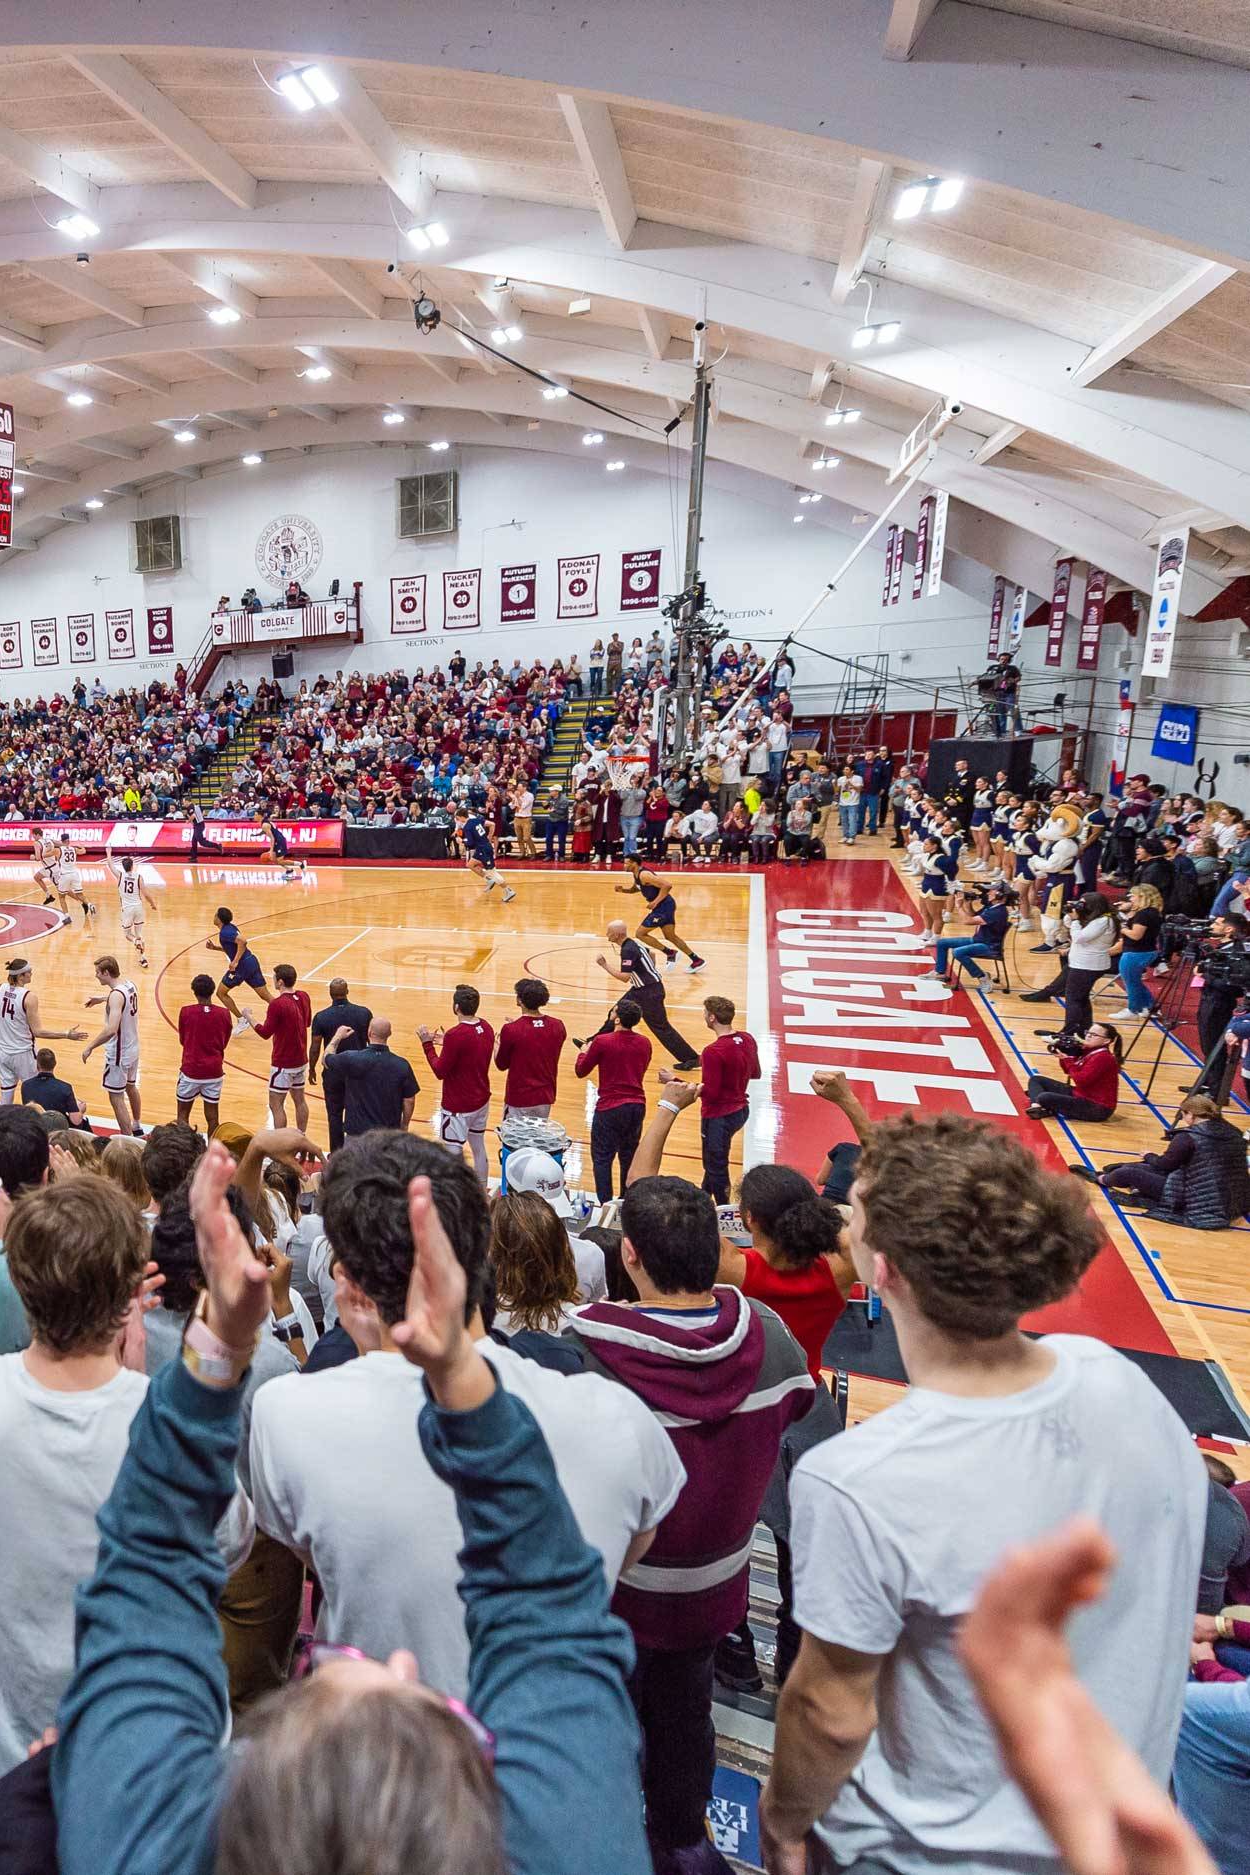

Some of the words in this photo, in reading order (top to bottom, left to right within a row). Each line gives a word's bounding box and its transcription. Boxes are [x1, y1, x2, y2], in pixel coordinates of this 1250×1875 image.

[631, 553, 653, 562] JUDY
[561, 559, 596, 569] ADONAL
[623, 560, 659, 570] CULHANE
[504, 567, 534, 576] AUTUMN
[565, 568, 591, 576] FOYLE
[446, 573, 478, 581] TUCKER
[637, 576, 644, 585] 9
[572, 583, 584, 593] 31
[456, 595, 467, 604] 20
[404, 600, 414, 610] 10
[336, 612, 344, 622] C
[723, 609, 767, 620] SECTION
[260, 616, 295, 628] COLGATE
[158, 627, 163, 635] 5
[216, 626, 223, 634] C
[405, 639, 438, 647] SECTION
[139, 662, 164, 670] SECTION
[300, 828, 317, 843] NJ
[64, 851, 75, 863] 33
[123, 880, 135, 894] 13
[1, 997, 15, 1020] 14
[776, 908, 1020, 1117] COLGATE
